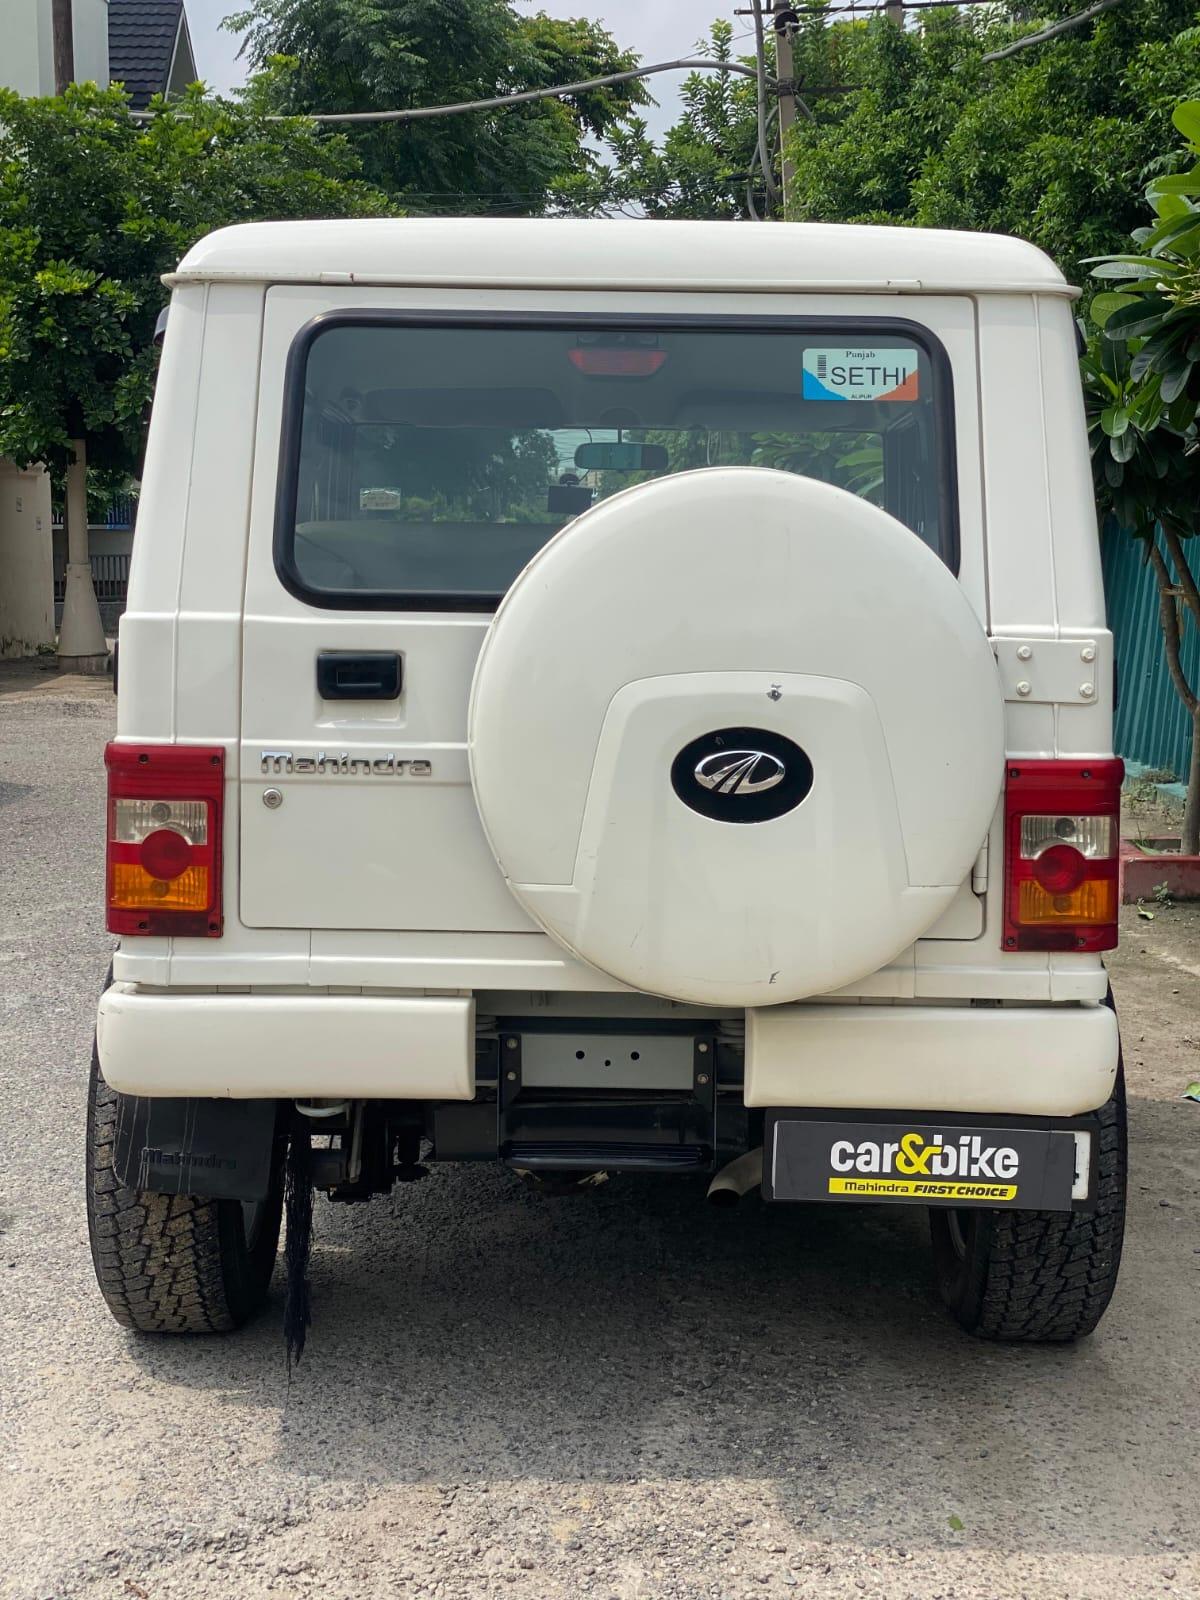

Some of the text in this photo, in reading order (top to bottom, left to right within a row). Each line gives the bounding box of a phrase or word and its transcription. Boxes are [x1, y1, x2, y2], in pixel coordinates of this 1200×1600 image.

[846, 350, 875, 361] Punjab
[830, 367, 907, 386] SETHI
[261, 750, 432, 776] Mahindra
[830, 1133, 1019, 1179] car&bike
[844, 1181, 1009, 1197] Mahindra FIRST CHOICE
